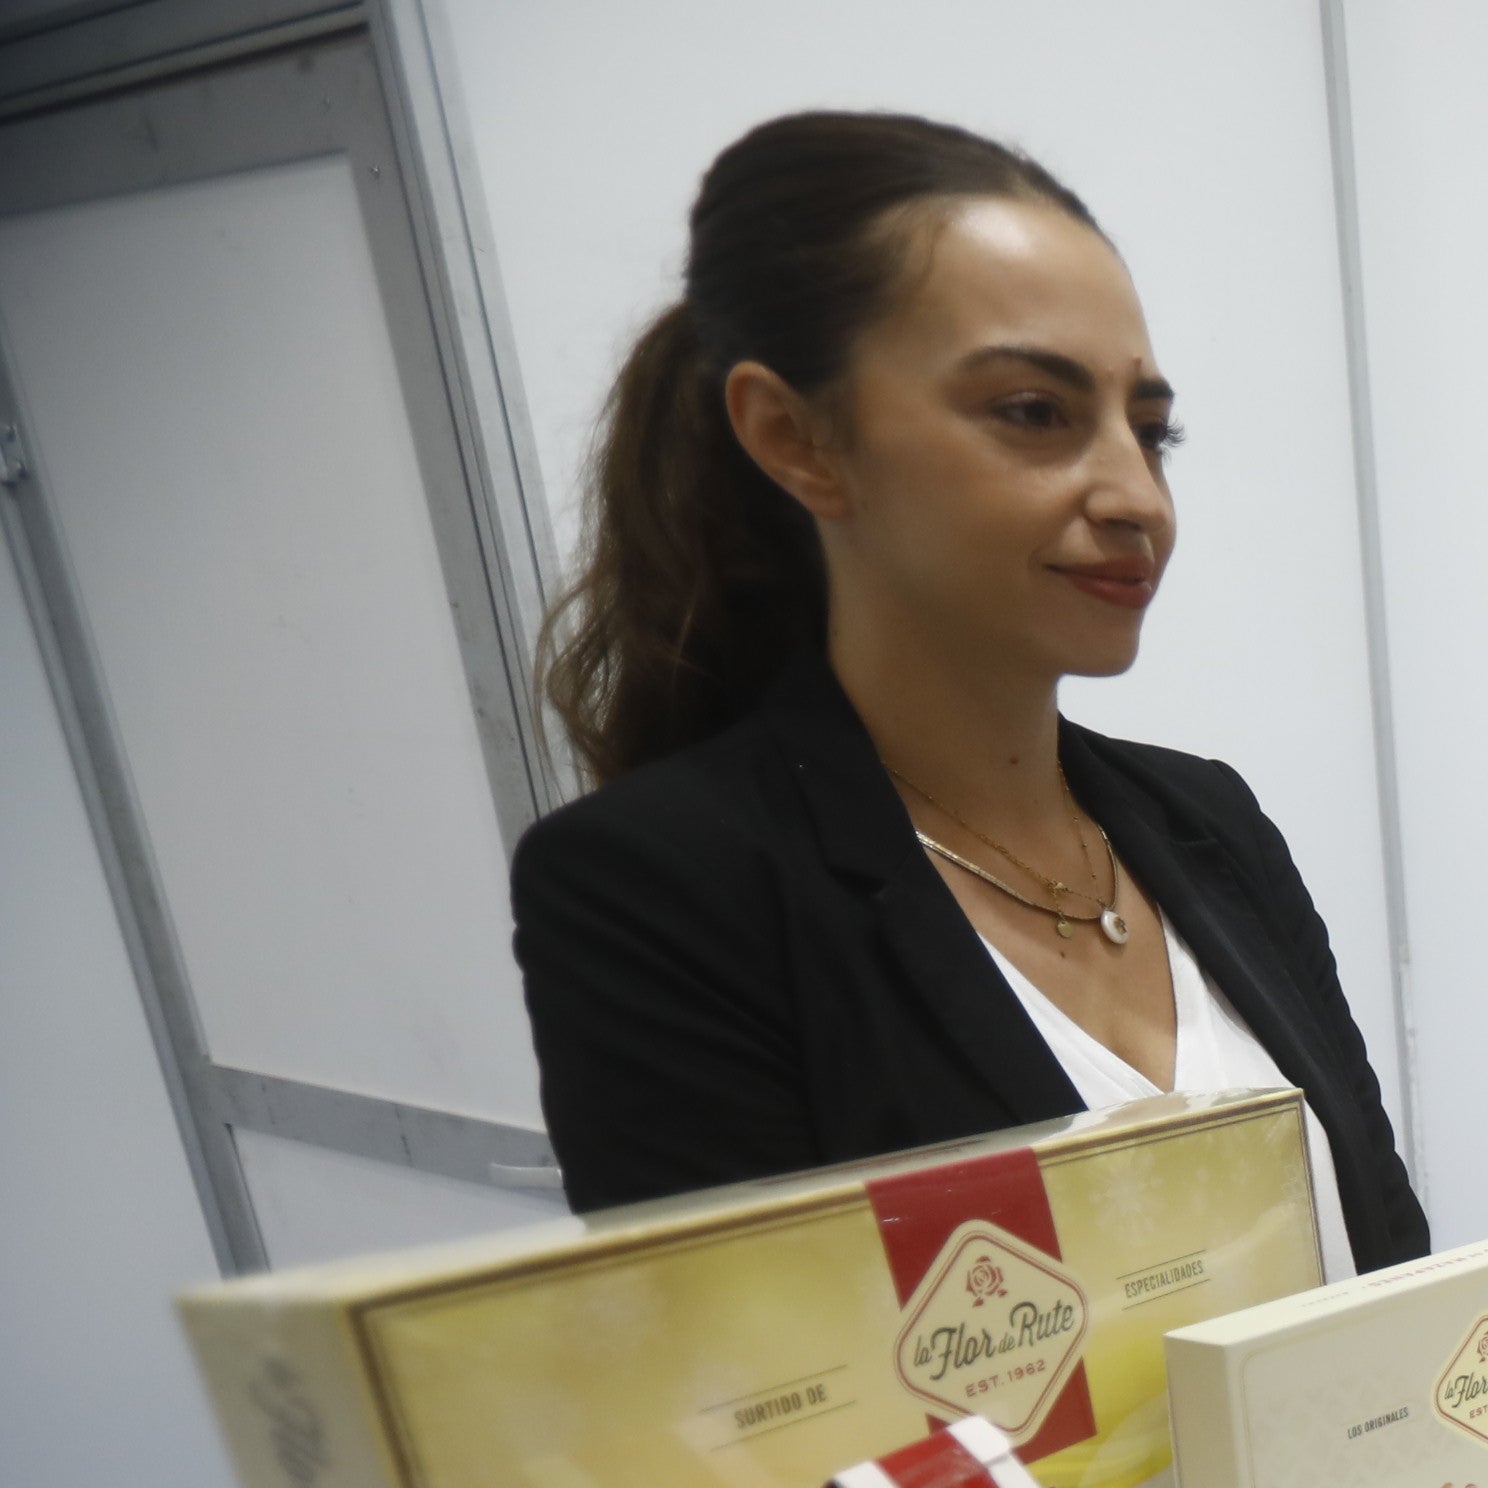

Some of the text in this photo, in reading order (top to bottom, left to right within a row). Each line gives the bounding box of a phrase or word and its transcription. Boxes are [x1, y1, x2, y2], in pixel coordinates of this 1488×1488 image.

[1124, 1259, 1204, 1299] ESPECIALIDADES
[914, 1301, 1074, 1381] la Flor de Rute
[1009, 1358, 1046, 1383] 1962
[734, 1383, 828, 1430] SURTIDO DE
[1347, 1406, 1409, 1440] LOS ORIGINALES
